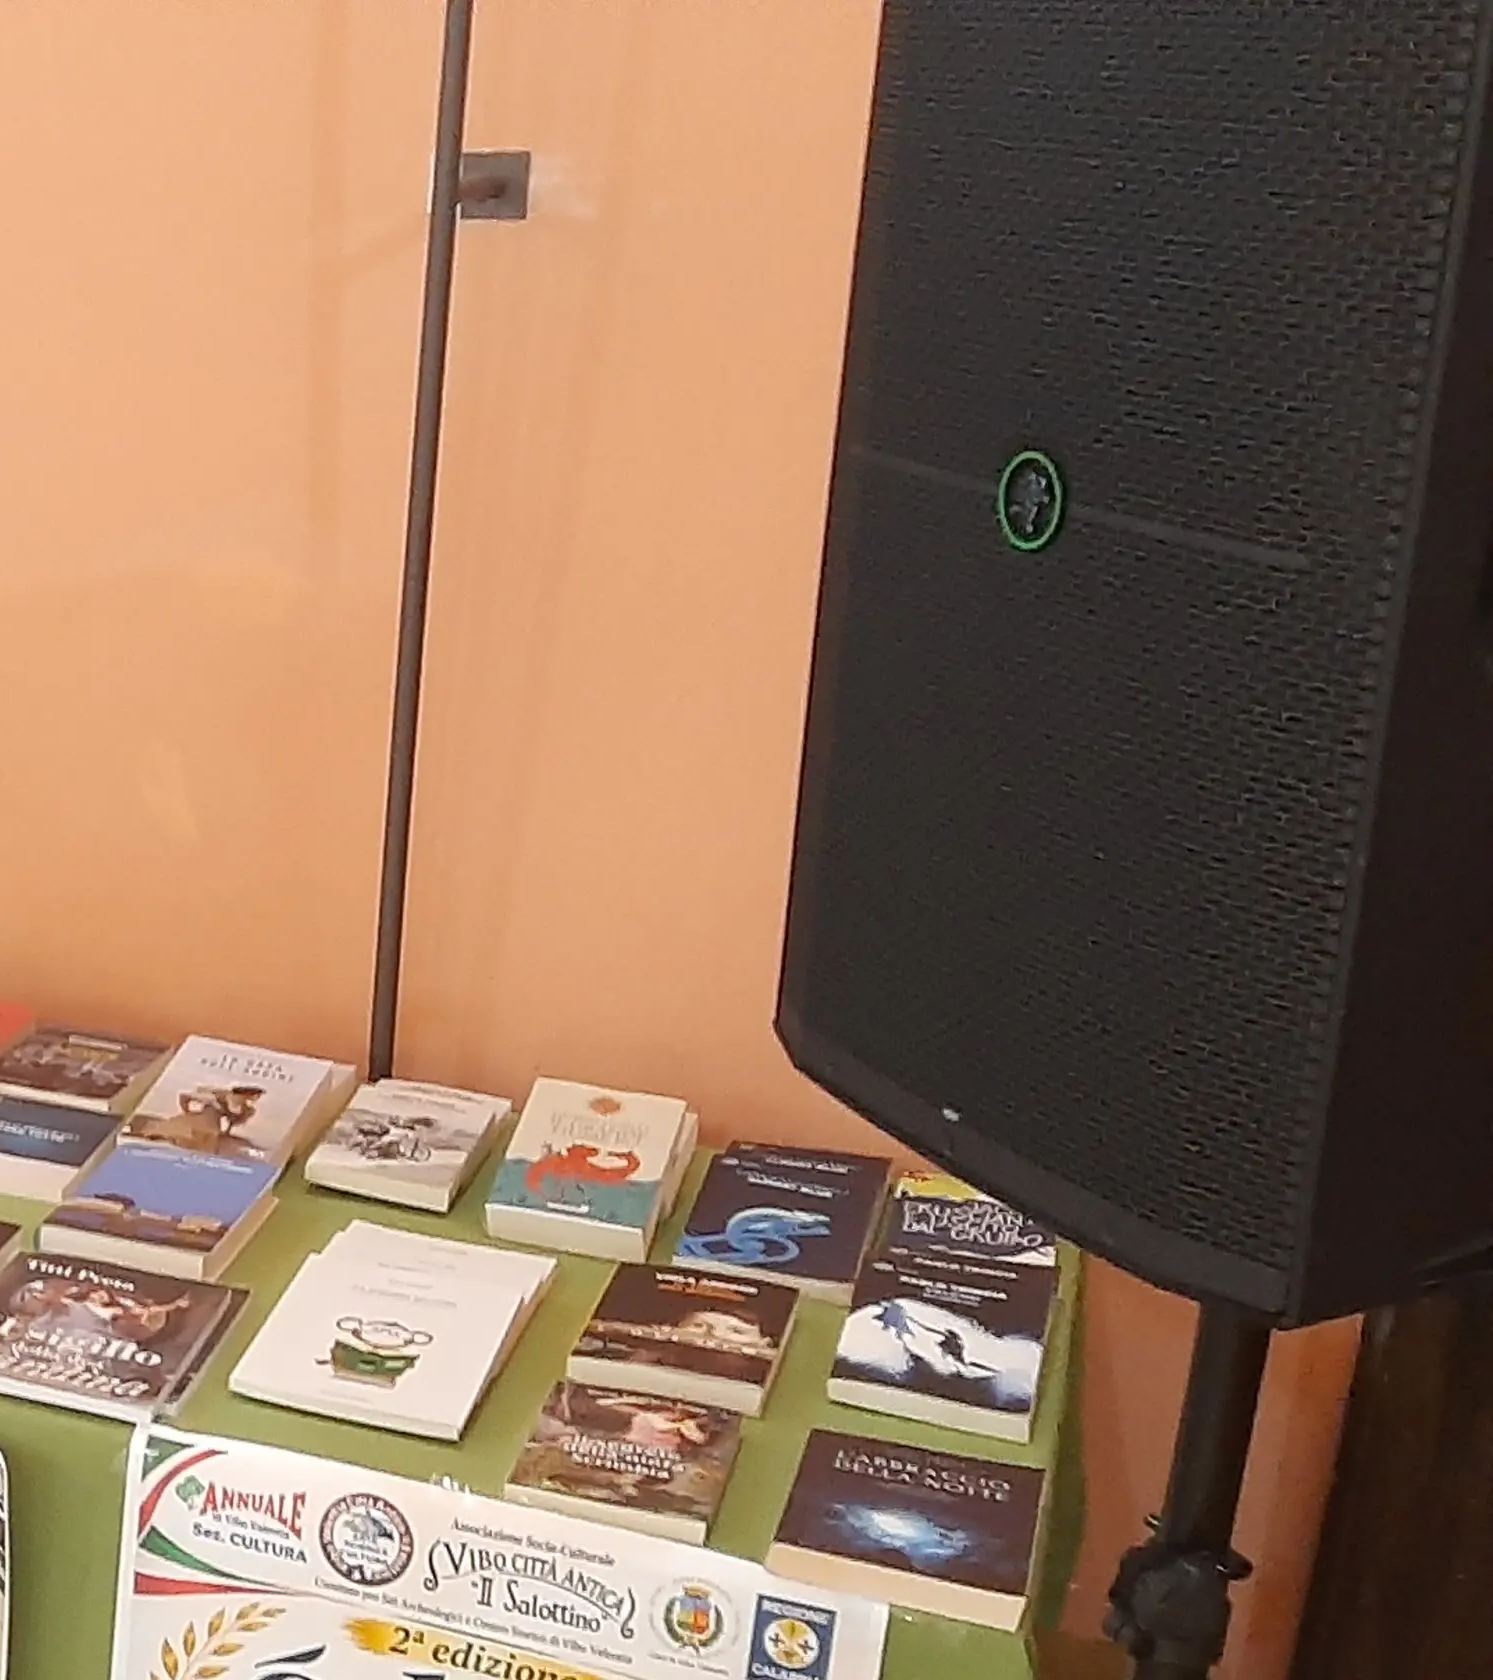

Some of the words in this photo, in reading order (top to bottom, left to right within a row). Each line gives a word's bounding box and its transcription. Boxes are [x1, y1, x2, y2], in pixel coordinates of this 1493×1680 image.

[199, 1481, 307, 1541] ANNUALE
[229, 1532, 308, 1564] CULTURA
[442, 1541, 507, 1577] VIBO
[561, 1566, 626, 1618] ANTICA
